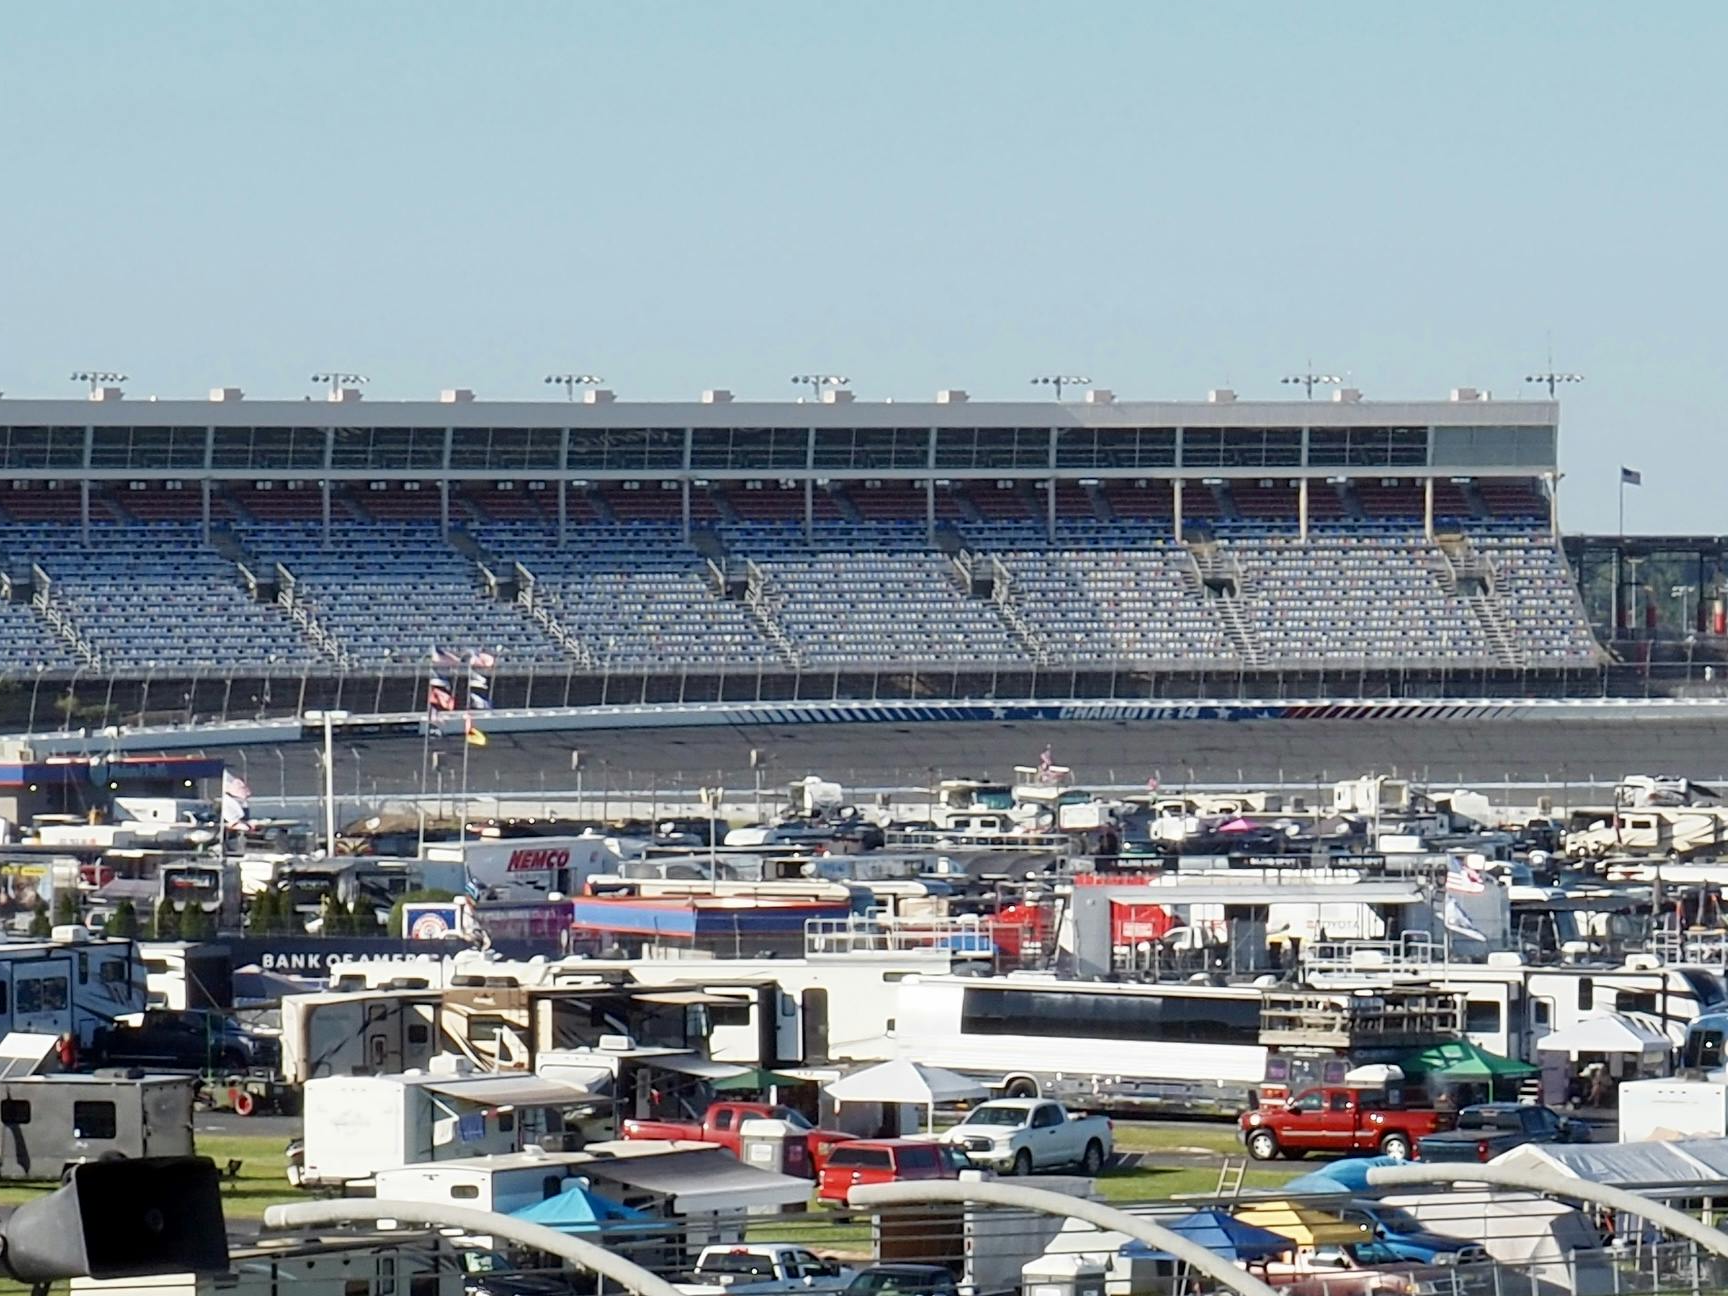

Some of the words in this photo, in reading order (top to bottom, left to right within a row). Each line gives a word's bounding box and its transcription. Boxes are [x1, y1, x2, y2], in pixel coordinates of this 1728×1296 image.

[1058, 706, 1174, 720] CHARLOTTE
[507, 849, 571, 872] NEMCO
[261, 953, 321, 969] BANK
[325, 953, 353, 968] OF
